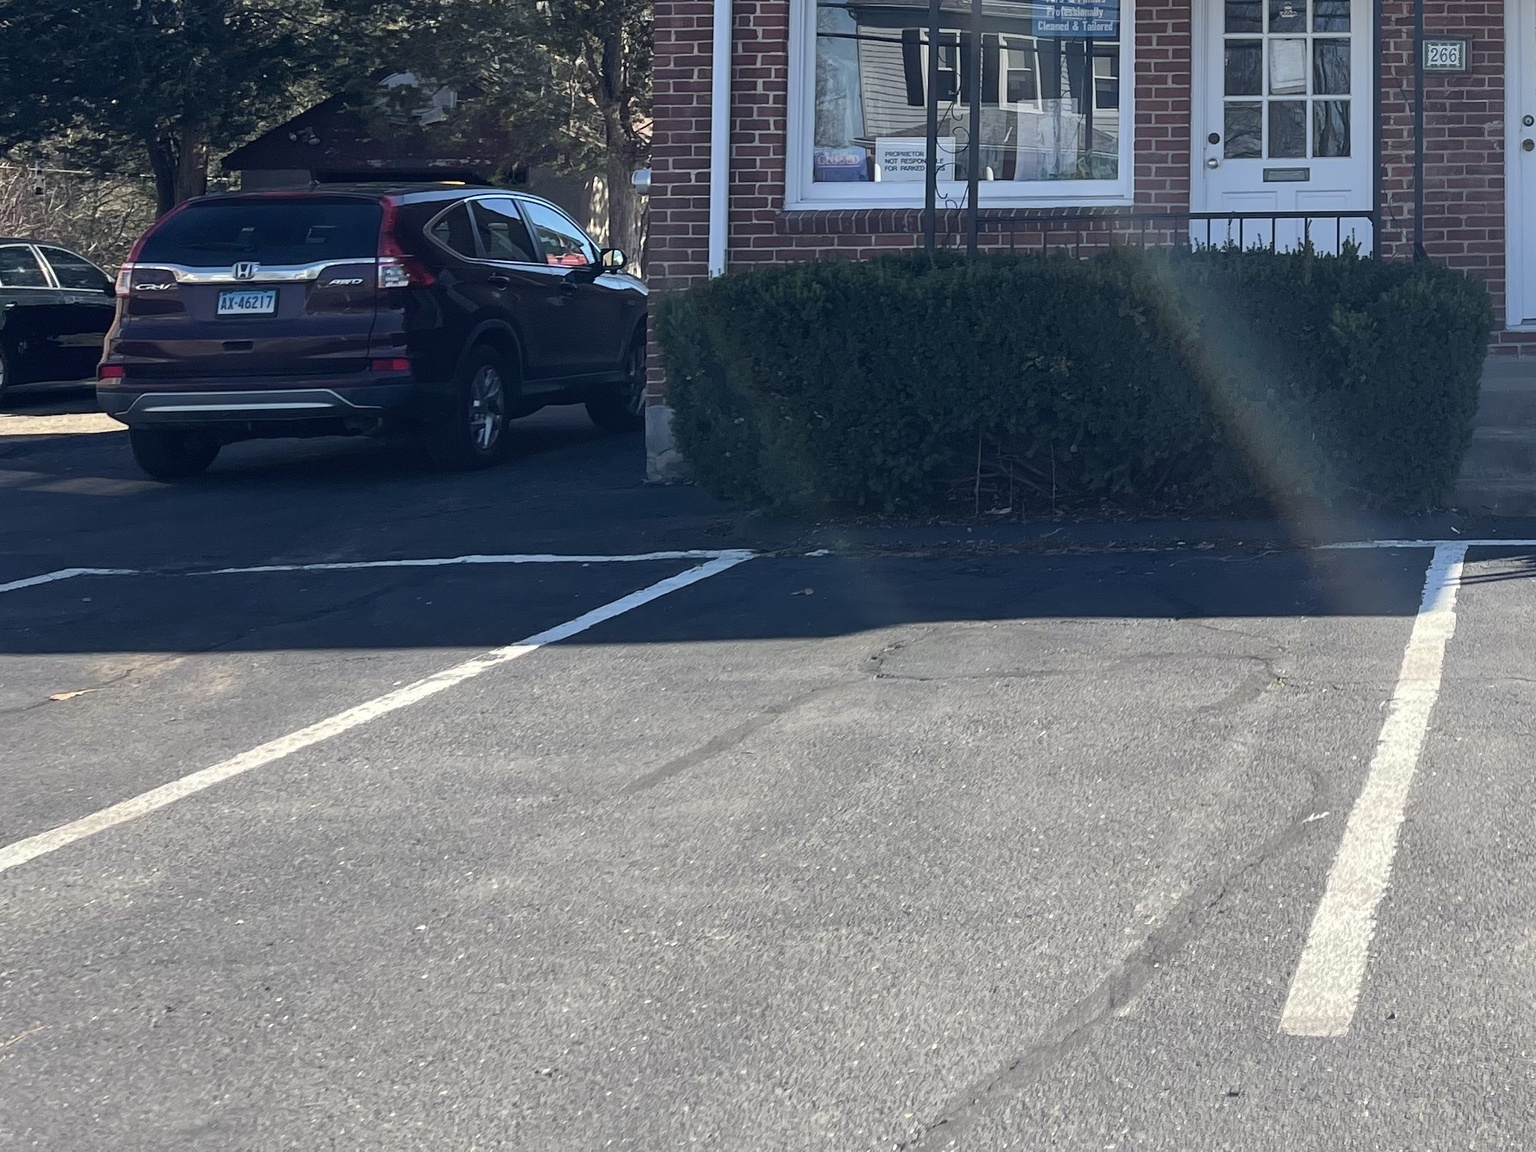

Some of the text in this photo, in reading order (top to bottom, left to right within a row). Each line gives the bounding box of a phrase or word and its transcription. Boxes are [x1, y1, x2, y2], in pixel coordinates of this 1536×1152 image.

[1046, 6, 1103, 18] Professionally
[1037, 21, 1113, 31] Cleaned & Tailored
[1430, 47, 1457, 63] 266
